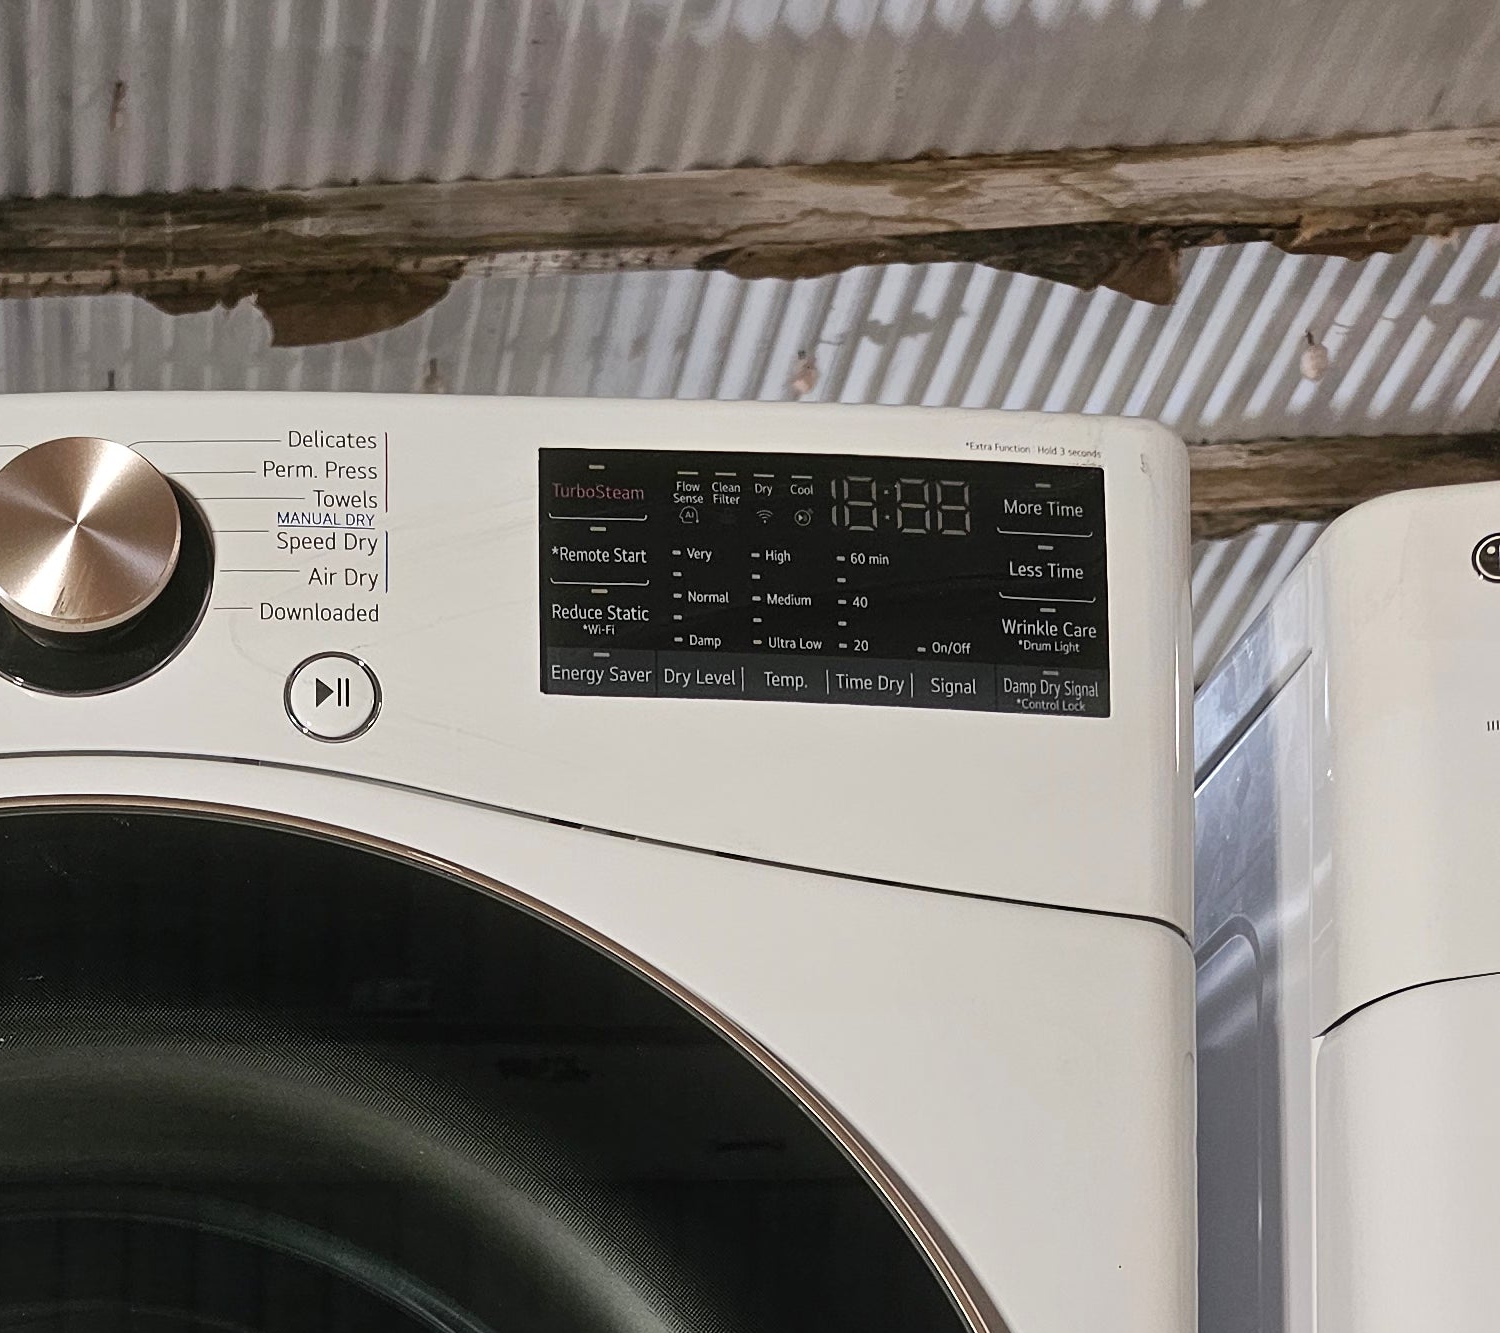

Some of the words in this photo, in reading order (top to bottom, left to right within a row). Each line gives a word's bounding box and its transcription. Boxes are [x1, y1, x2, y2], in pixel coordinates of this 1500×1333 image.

[288, 430, 377, 449] Delicates
[1037, 446, 1057, 456] Hold
[1060, 447, 1066, 456] 3
[1067, 449, 1102, 459] seconds
[263, 460, 318, 479] Perm.
[325, 461, 378, 480] Press
[552, 482, 645, 501] TurboSteam
[676, 481, 700, 492] Flow
[711, 481, 741, 493] Clean
[754, 483, 773, 497] Dry
[790, 484, 814, 496] Cool
[313, 489, 378, 509] Towels
[673, 493, 704, 504] Sense
[713, 494, 740, 505] Filter
[1003, 498, 1042, 515] More
[1047, 501, 1083, 518] Time
[277, 511, 341, 526] MANUAL
[345, 513, 375, 527] DRY
[276, 531, 336, 555] Speed
[344, 533, 378, 556] Dry
[613, 547, 648, 564] Start
[686, 547, 713, 562] Very
[765, 550, 791, 565] High
[850, 553, 865, 565] 60
[868, 553, 890, 566] min
[1009, 560, 1043, 578] Less
[1047, 562, 1084, 579] Time
[308, 567, 337, 586] Air
[345, 568, 379, 592] Dry
[688, 591, 730, 604] Normal
[766, 593, 812, 606] Medium
[852, 596, 868, 609] 40
[260, 602, 379, 622] Downloaded
[552, 603, 603, 620] Reduce
[607, 605, 650, 622] Static
[1001, 618, 1058, 637] Wrinkle
[1062, 622, 1097, 638] Care
[689, 634, 722, 649] Damp
[768, 637, 797, 649] Ultra
[799, 637, 823, 650] Low
[853, 640, 869, 652] 20
[931, 641, 971, 655] On/Off
[1055, 641, 1080, 655] Light
[551, 664, 604, 685] Energy
[609, 666, 652, 683] Saver
[664, 668, 692, 688] Dry
[696, 669, 736, 686] Level
[764, 671, 808, 691] Temp.
[836, 673, 873, 690] Time
[878, 675, 905, 695] Dry
[930, 677, 976, 698] Signal
[1003, 677, 1037, 697] Damp
[1040, 679, 1060, 699] Dry
[1064, 681, 1099, 700] Signal
[1062, 700, 1086, 712] Lock
